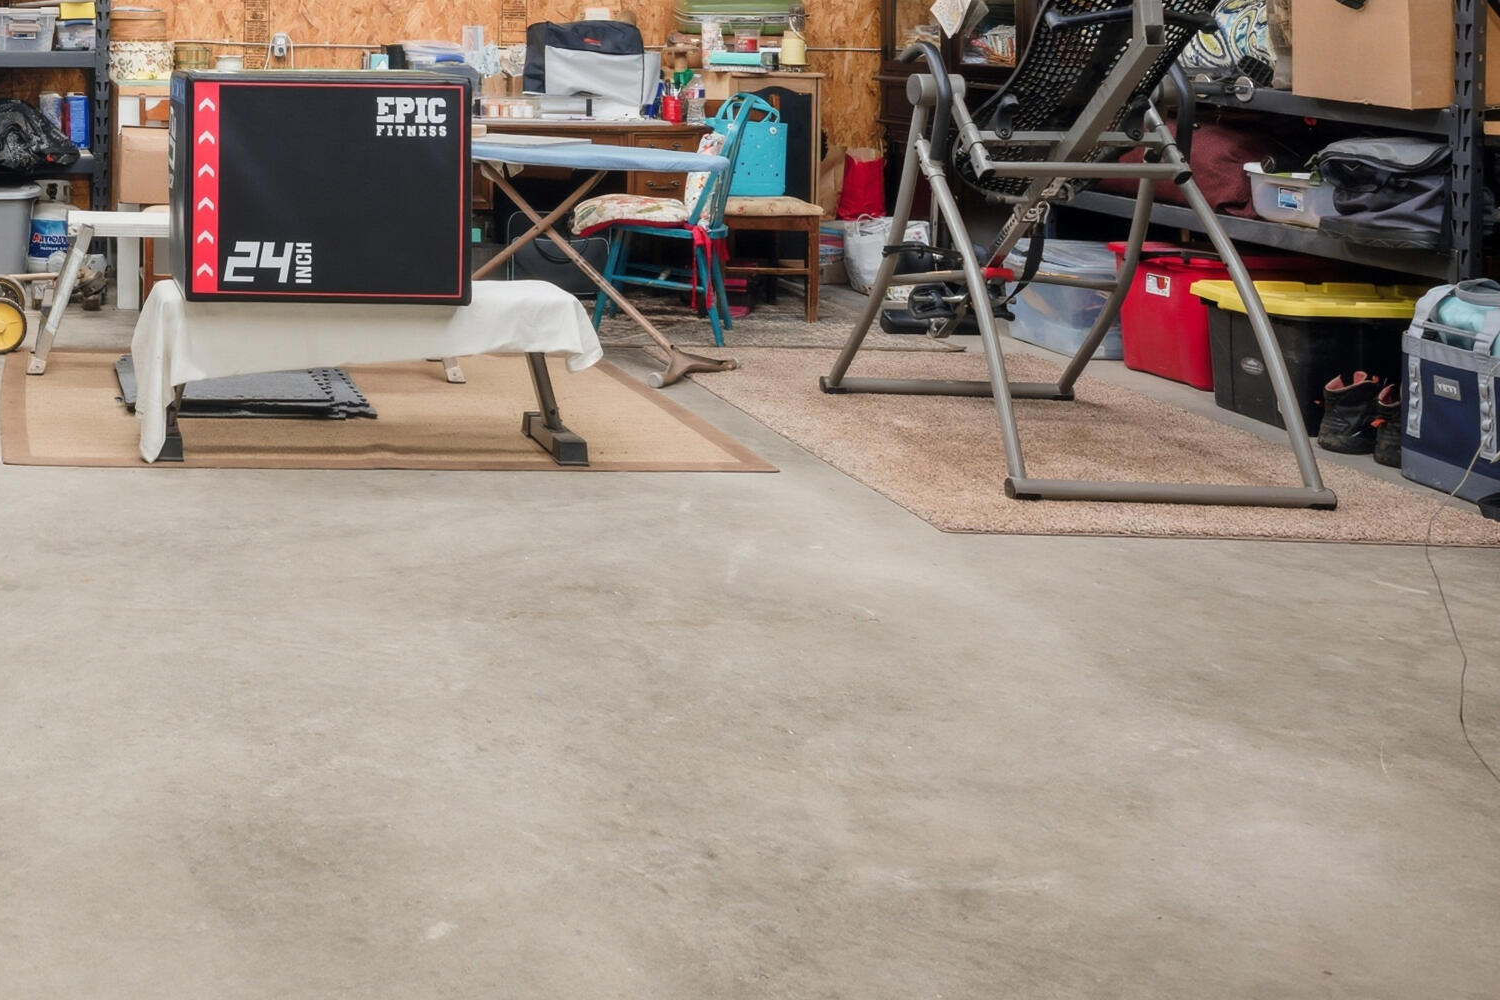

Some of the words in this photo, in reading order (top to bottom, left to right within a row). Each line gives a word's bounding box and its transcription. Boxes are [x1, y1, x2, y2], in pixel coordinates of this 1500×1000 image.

[376, 97, 447, 123] EPIC
[376, 125, 447, 137] FITNESS
[223, 241, 294, 284] 24
[295, 242, 312, 284] INCH
